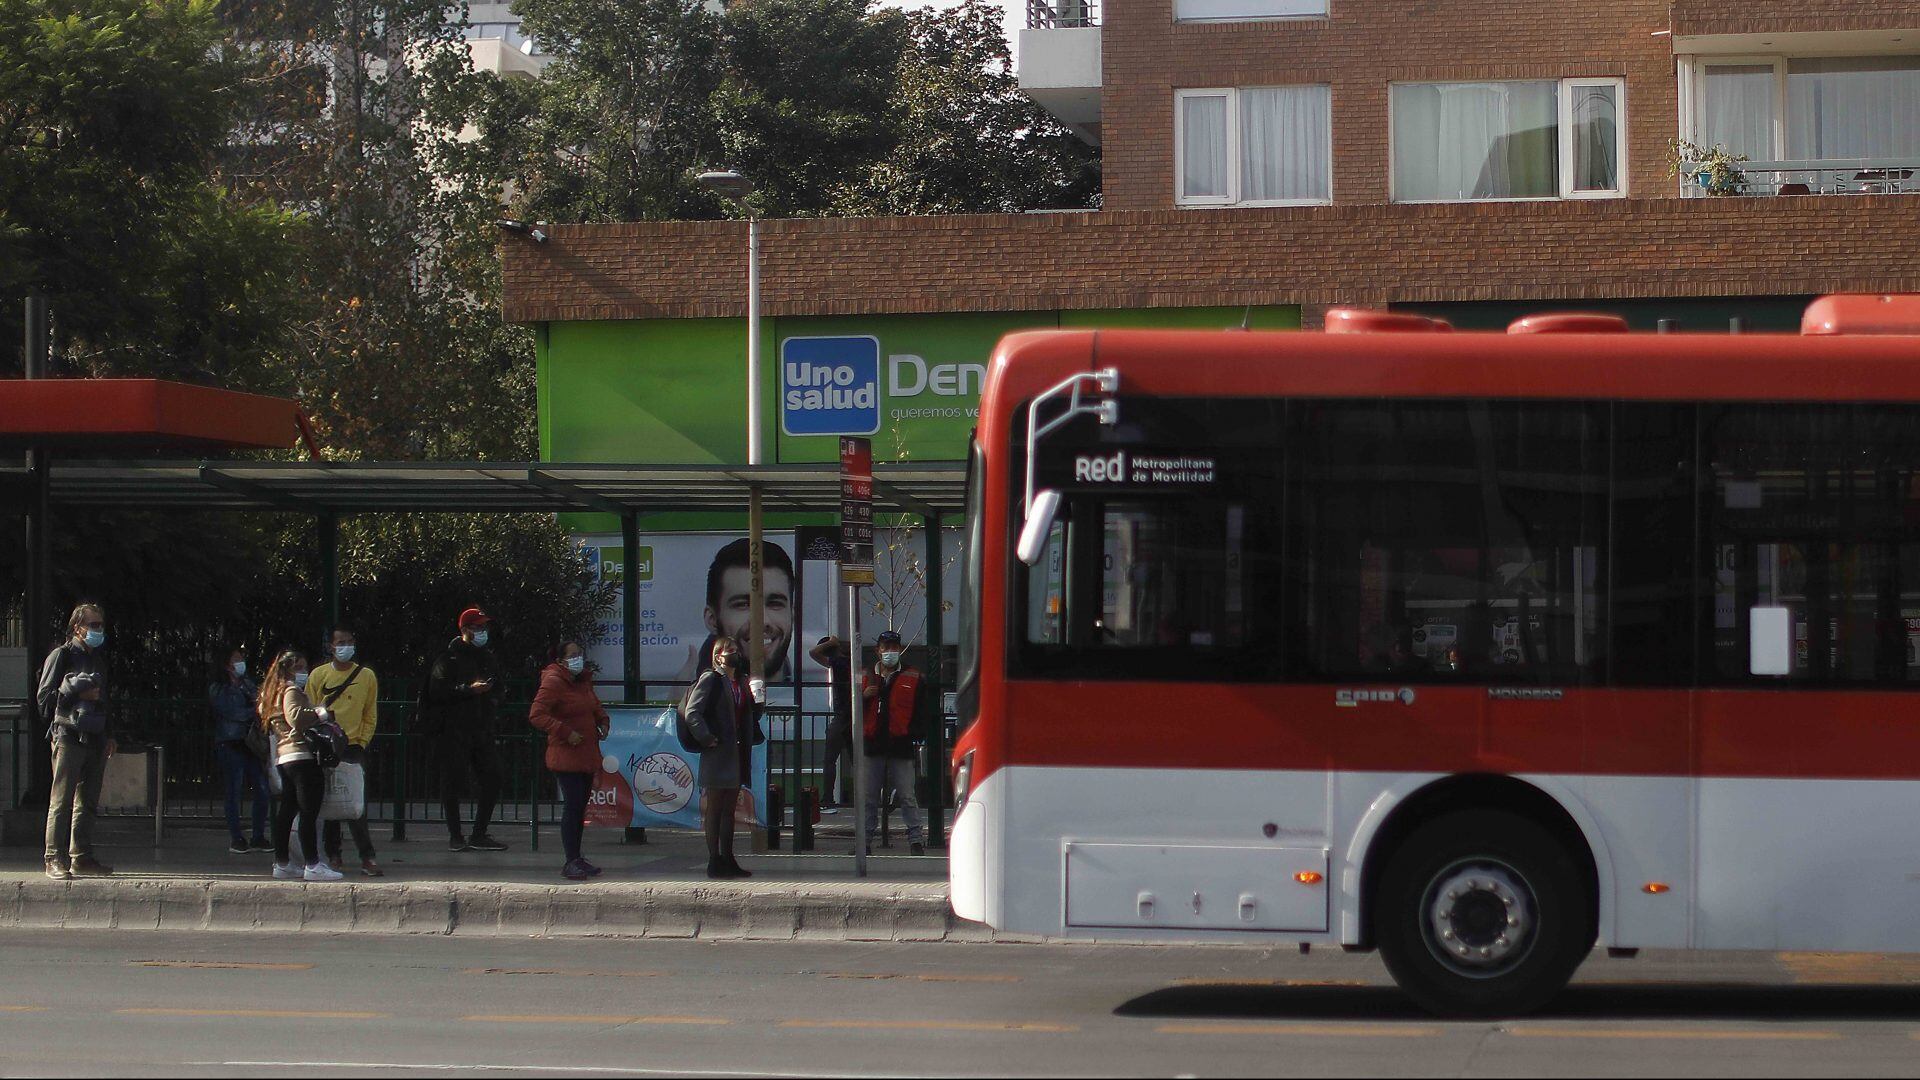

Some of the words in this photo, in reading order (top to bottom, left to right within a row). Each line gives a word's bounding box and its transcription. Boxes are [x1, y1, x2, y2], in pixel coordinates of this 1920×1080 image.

[786, 362, 855, 387] Uno
[786, 382, 875, 411] salud
[890, 407, 961, 419] queremos
[1075, 452, 1125, 482] Red
[1132, 458, 1213, 470] Metropolitana
[1132, 472, 1147, 482] de
[1152, 472, 1213, 482] Movilidad
[603, 560, 651, 574] Deal
[641, 609, 656, 619] es
[587, 787, 617, 806] Red
